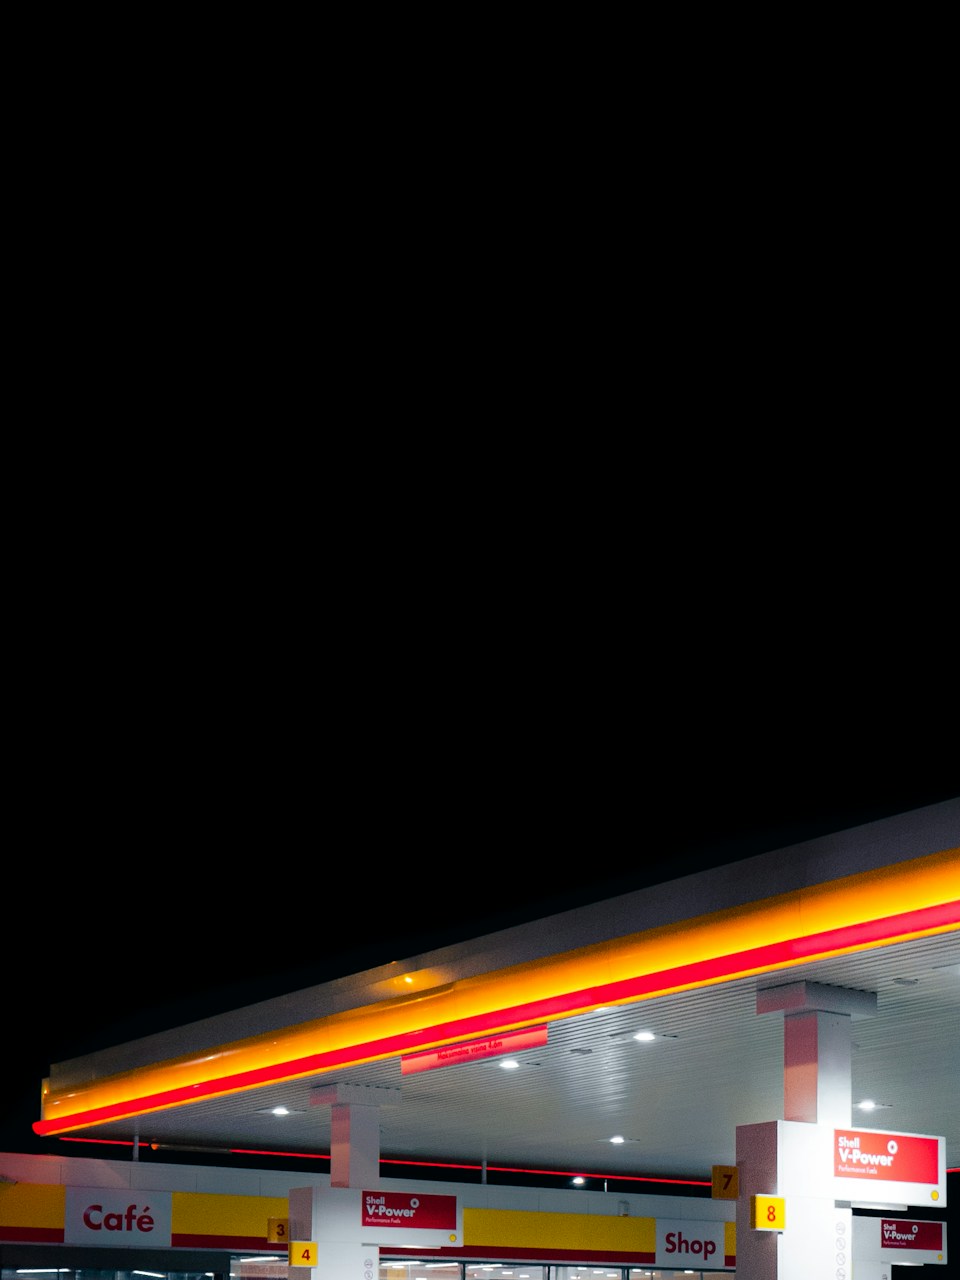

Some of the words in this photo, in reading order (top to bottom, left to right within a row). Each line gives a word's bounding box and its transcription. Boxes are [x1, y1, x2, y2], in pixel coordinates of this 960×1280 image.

[838, 1136, 860, 1149] Shell
[838, 1148, 893, 1167] V-Power
[838, 1165, 865, 1174] Performance
[866, 1166, 878, 1175] Fuels
[723, 1174, 733, 1190] 7
[366, 1196, 385, 1204] Shell
[366, 1204, 415, 1218] V-Power
[767, 1205, 776, 1222] 8
[83, 1204, 155, 1232] Café
[276, 1223, 285, 1236] 3
[884, 1223, 896, 1231] Shell
[884, 1231, 916, 1240] V-Power
[665, 1231, 716, 1261] Shop
[301, 1249, 311, 1260] 4
